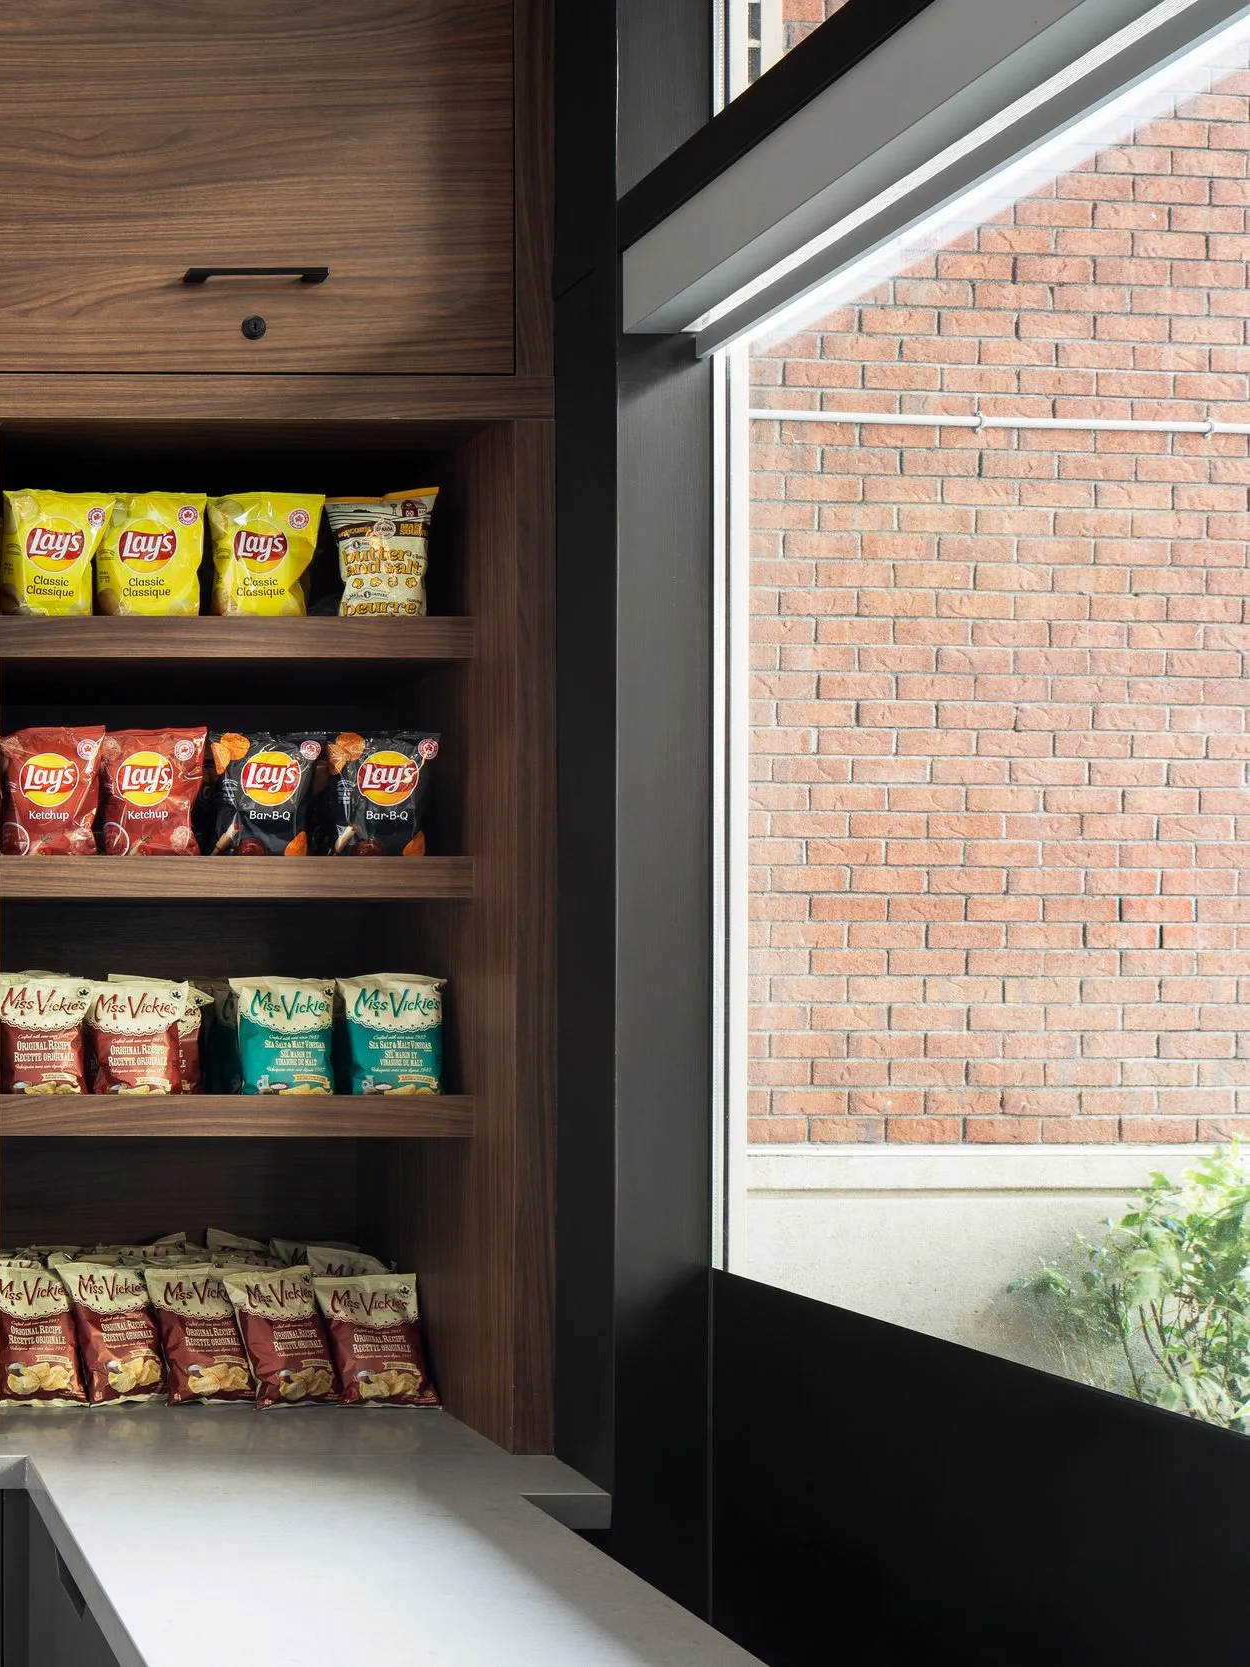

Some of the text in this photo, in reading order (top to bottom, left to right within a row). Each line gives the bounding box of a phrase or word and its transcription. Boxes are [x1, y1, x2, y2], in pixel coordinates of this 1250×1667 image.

[29, 528, 82, 560] Lay's
[122, 531, 174, 562] Lay's
[237, 531, 284, 563] Lay's
[342, 545, 412, 566] butter
[346, 559, 423, 578] and salt
[33, 575, 69, 587] Classic
[128, 577, 165, 587] Classic
[243, 577, 278, 587] Classic
[26, 585, 74, 599] Classique
[122, 587, 171, 599] Classique
[236, 587, 285, 598] Classique
[341, 600, 417, 617] beurre
[24, 765, 75, 794] Lay's
[121, 765, 171, 794] Lay's
[245, 763, 298, 793] Lay's
[362, 764, 414, 793] Lay's
[29, 810, 70, 821] Ketchup
[128, 810, 169, 820] Ketchup
[0, 987, 87, 1016] Miss Vickie's
[94, 993, 127, 1022] Miss
[127, 993, 179, 1019] Vickie's
[251, 989, 281, 1018] Miss
[354, 988, 441, 1018] Miss Vickie's
[17, 1040, 72, 1051] ORIGINAL RECIPE
[110, 1045, 142, 1055] ORIGINAL
[368, 1041, 379, 1049] SEA
[14, 1052, 75, 1063] RECETTE ORIGINALE
[108, 1056, 136, 1067] RECETTE
[0, 1278, 22, 1306] Miss
[78, 1273, 147, 1301] Miss Vickie's
[164, 1281, 194, 1306] Miss
[245, 1280, 314, 1308] Miss Vickie's
[331, 1290, 410, 1317] Miss Vickie's
[10, 1325, 62, 1335] ORIGINAL RECIPE
[127, 1320, 148, 1331] RECIPE
[185, 1327, 236, 1337] ORIGINAL RECIPE
[8, 1335, 66, 1345] RECETTE ORIGINALE
[185, 1336, 211, 1346] RECETTE
[354, 1333, 407, 1343] ORIGINAL RECIPE
[352, 1343, 412, 1353] RECETTE ORIGINALE
